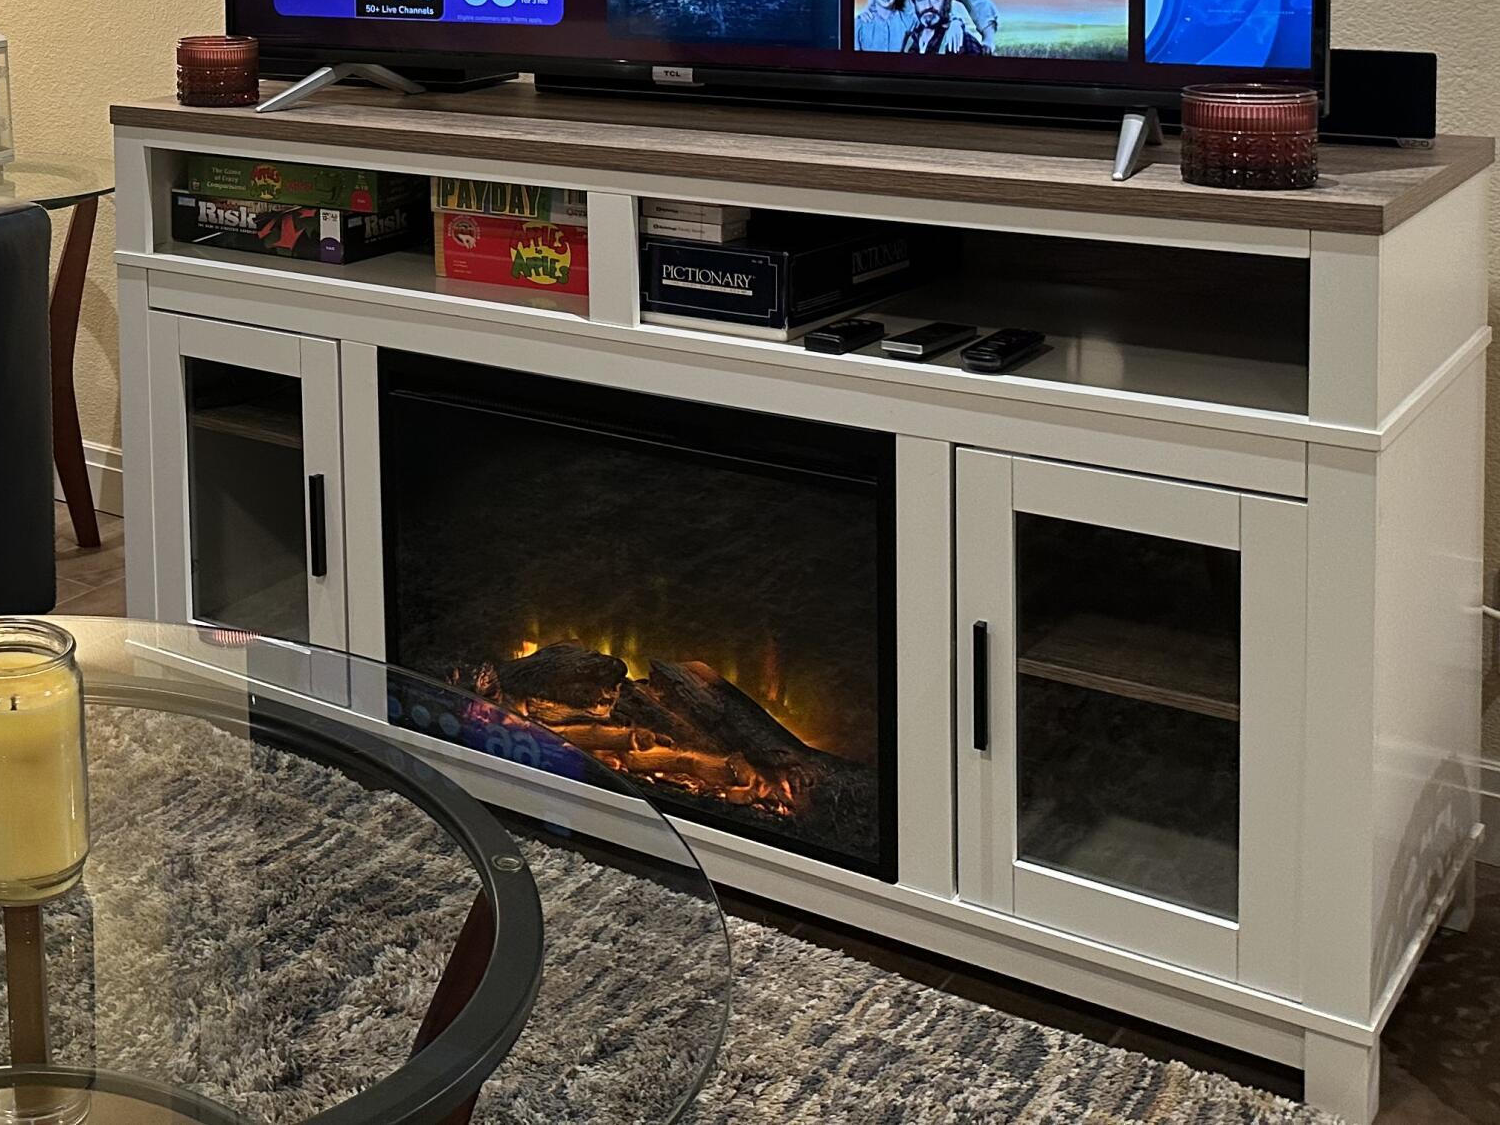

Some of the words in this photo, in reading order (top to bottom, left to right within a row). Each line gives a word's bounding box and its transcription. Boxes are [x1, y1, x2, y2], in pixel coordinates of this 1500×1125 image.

[365, 4, 380, 13] 50+
[382, 5, 397, 14] Live
[399, 6, 434, 15] Channels
[440, 177, 540, 218] PAYDAY
[662, 264, 752, 288] PICTIONARY
